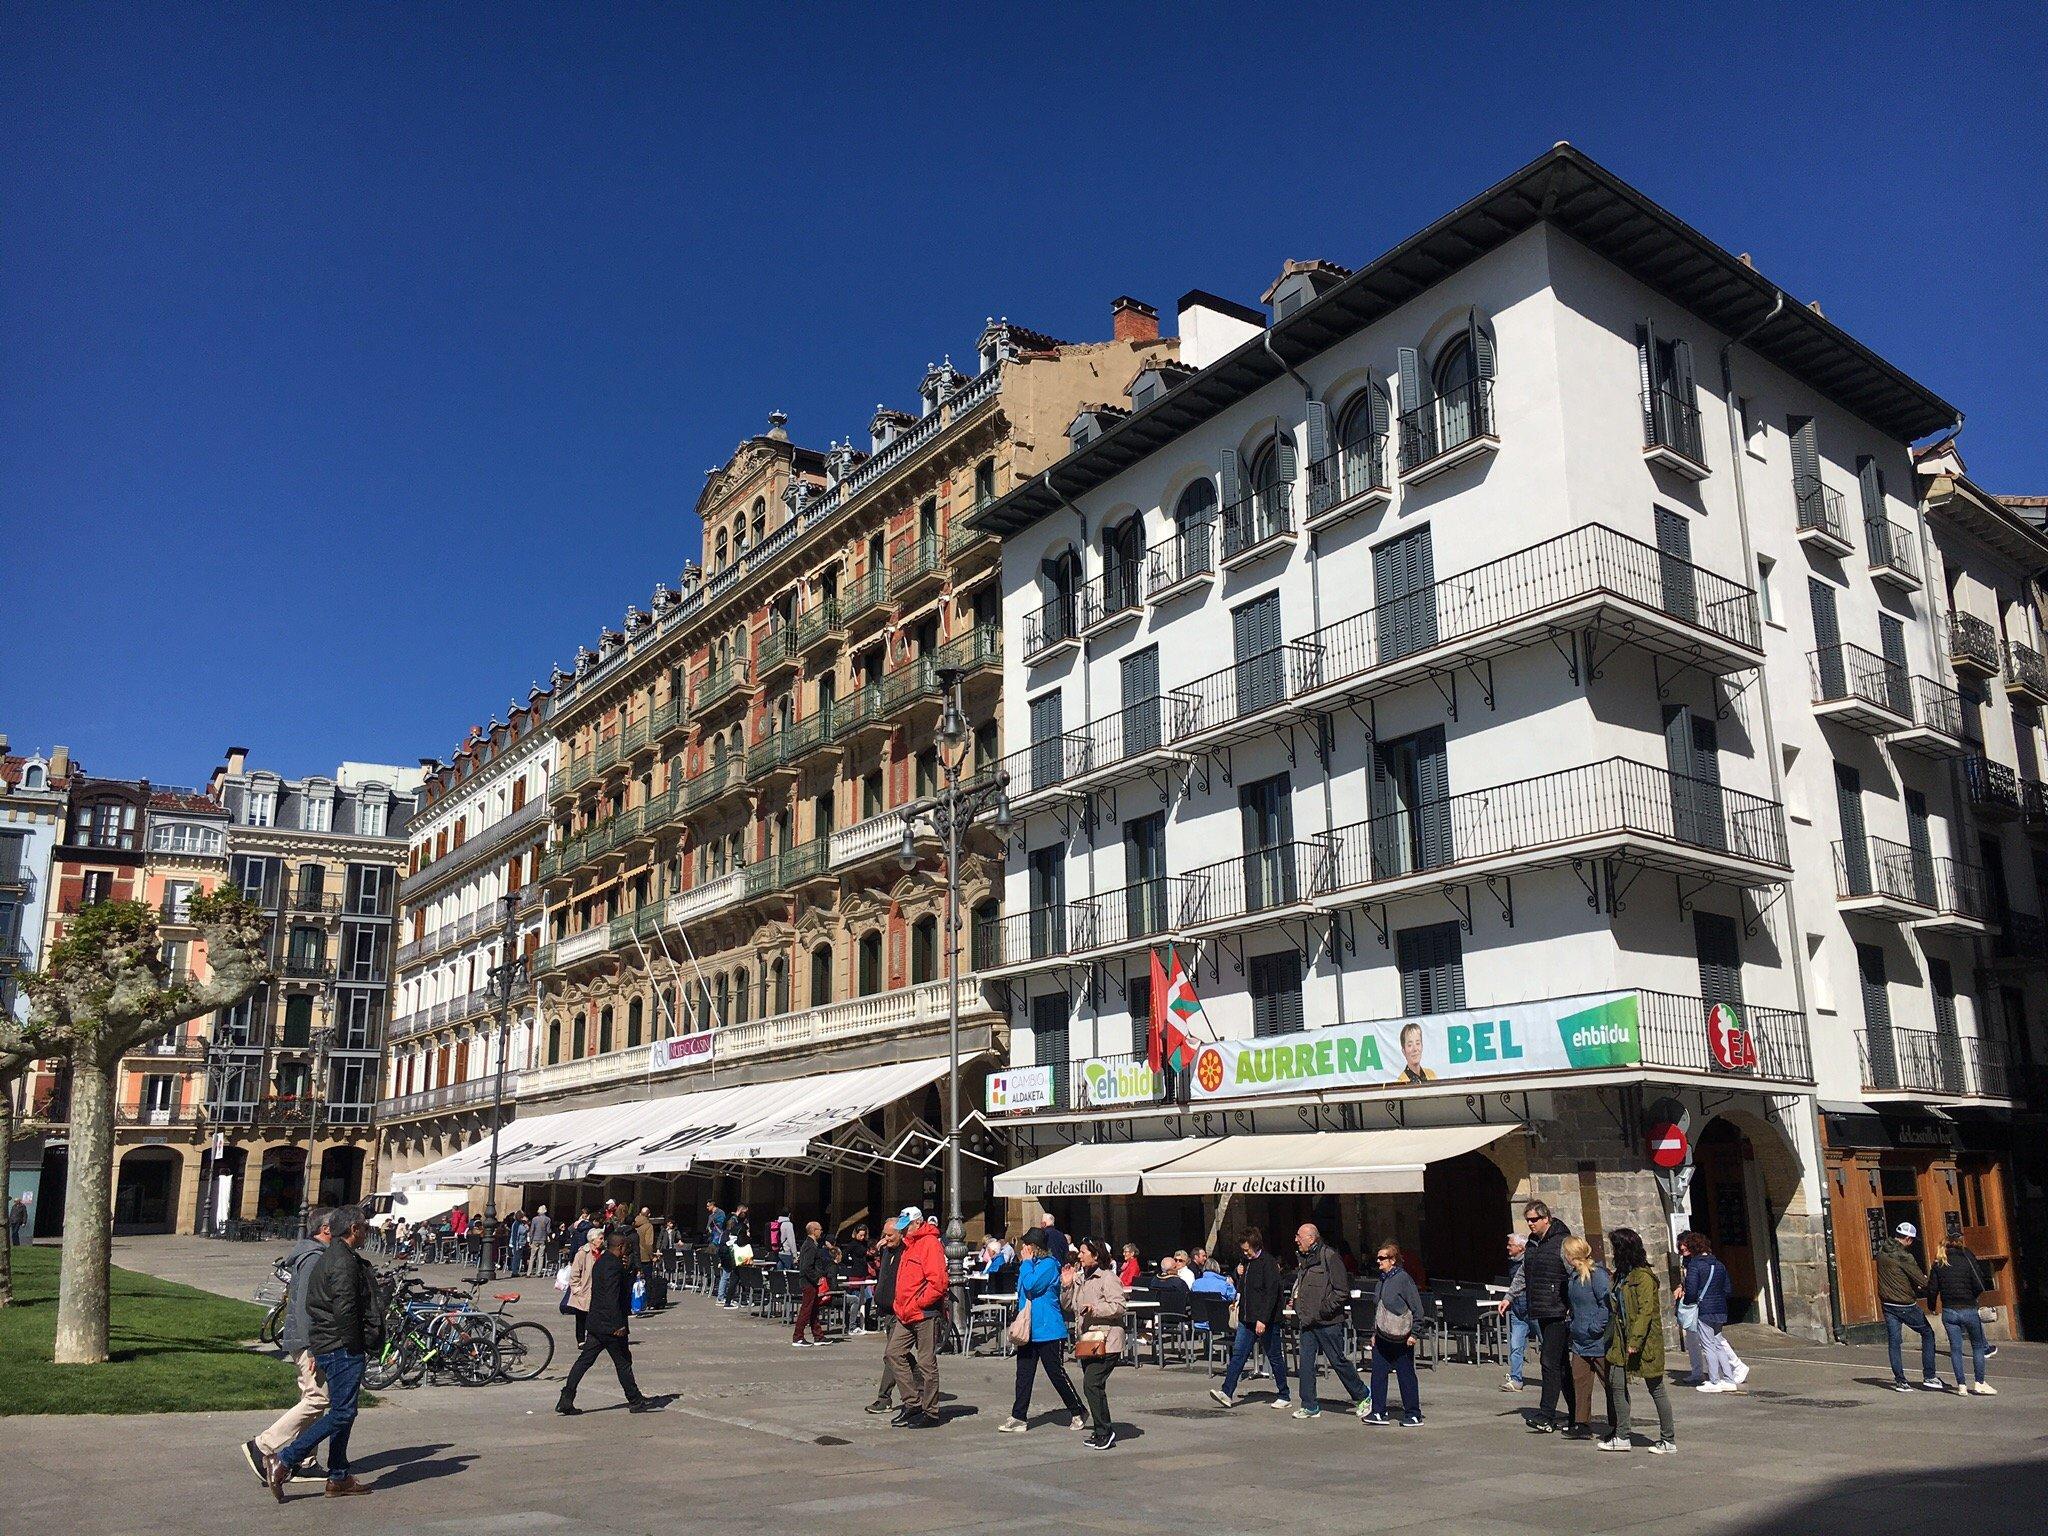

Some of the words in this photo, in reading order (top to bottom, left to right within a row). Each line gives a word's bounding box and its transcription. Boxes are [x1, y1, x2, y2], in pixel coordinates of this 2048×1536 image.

[1572, 1023, 1630, 1048] ehbildu
[1235, 1035, 1383, 1084] AURRERA
[1447, 1019, 1523, 1064] BEL
[1727, 1029, 1758, 1068] EA
[1011, 1073, 1045, 1088] CAMBIO
[1012, 1090, 1045, 1103] ALDAKETA
[1025, 1182, 1043, 1194] bar
[1046, 1179, 1103, 1194] delcastillo
[1213, 1178, 1237, 1192] bar
[1242, 1176, 1325, 1192] delcastillo
